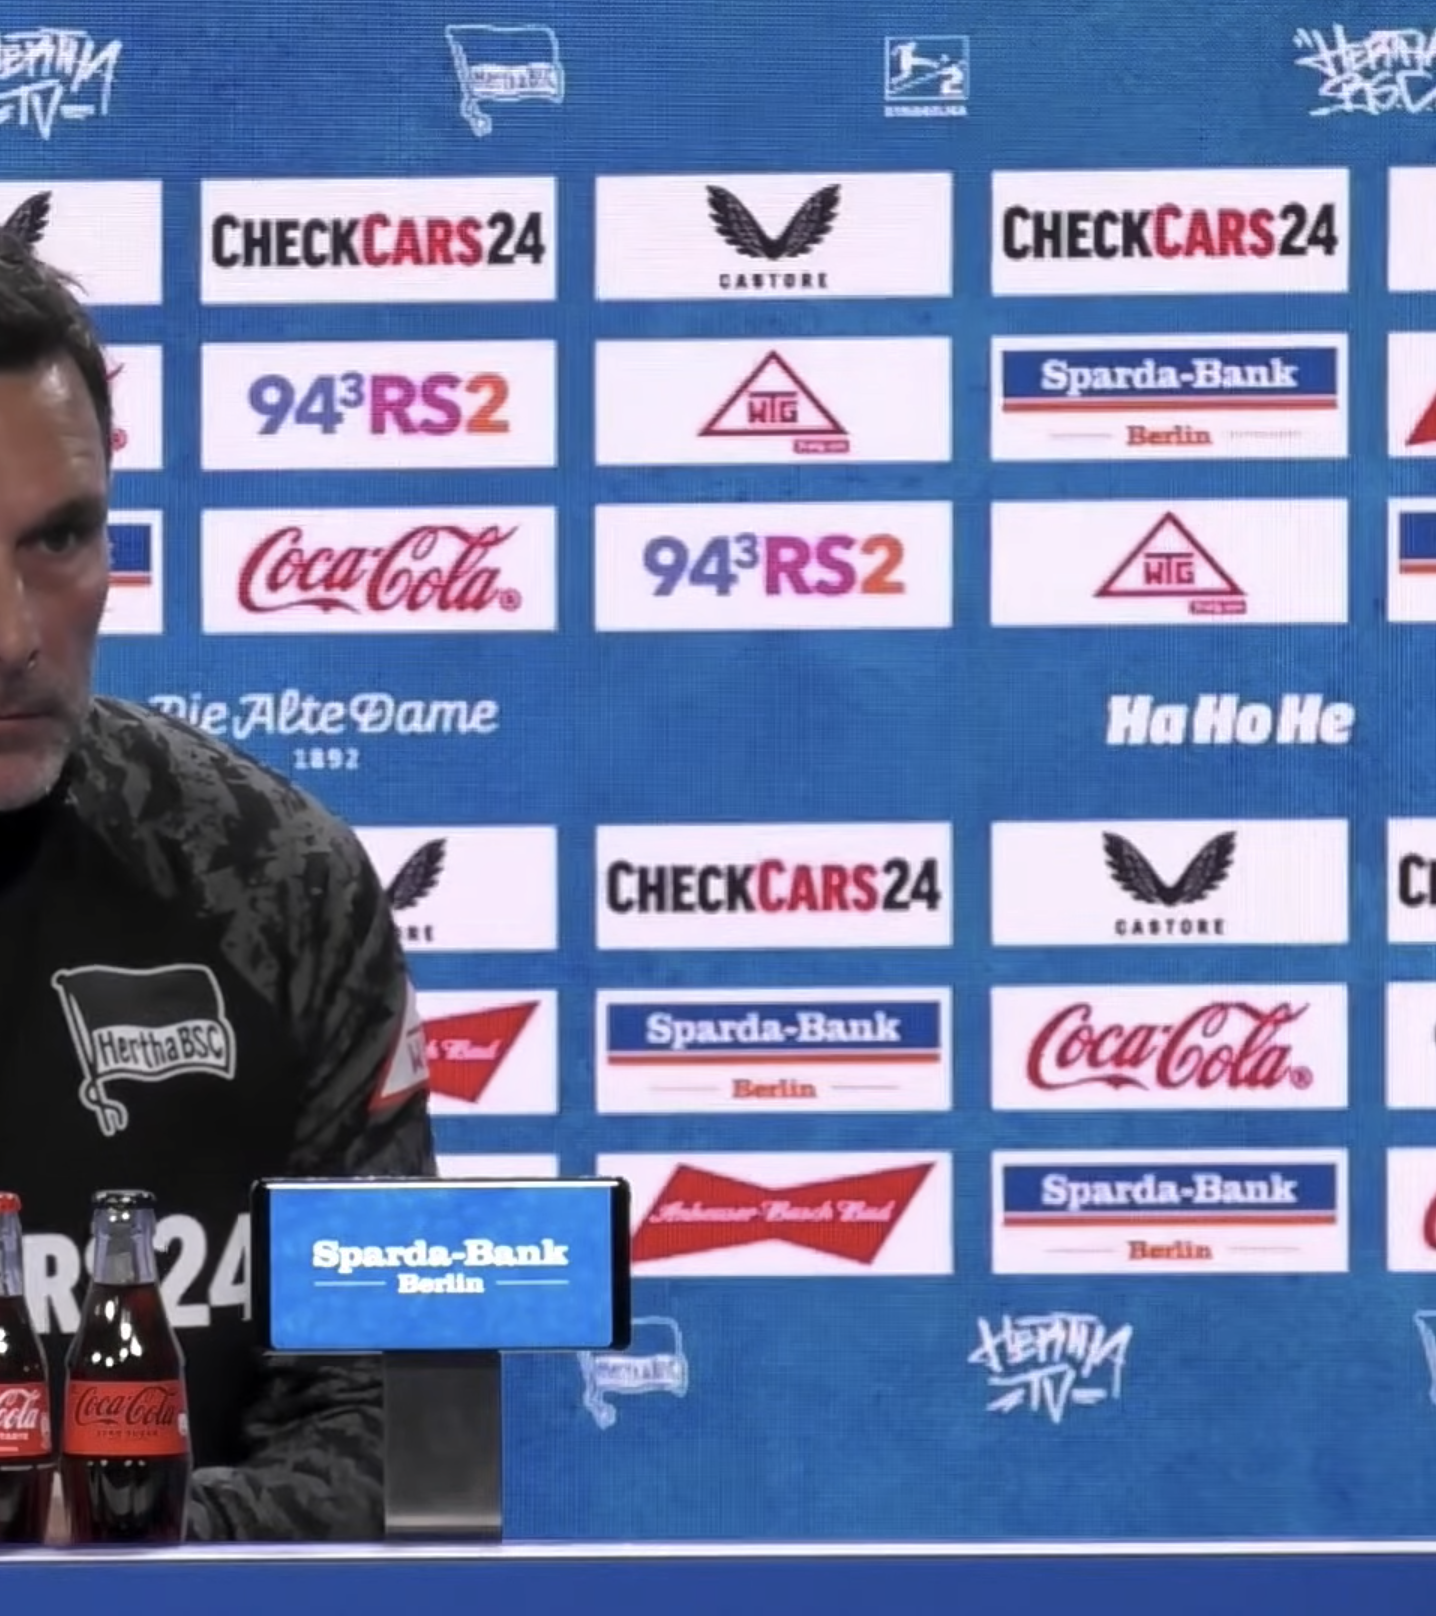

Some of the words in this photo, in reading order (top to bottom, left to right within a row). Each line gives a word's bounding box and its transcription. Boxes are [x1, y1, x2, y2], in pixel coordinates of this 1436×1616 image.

[719, 272, 827, 290] CASTORE
[1041, 358, 1297, 397] Sparda-Bank
[1127, 425, 1212, 446] Berlin
[237, 525, 520, 614] Coca-Cola
[232, 688, 347, 740] Alte
[348, 693, 498, 734] Dame
[1115, 918, 1223, 936] CASTORE
[647, 1012, 900, 1049] Sparda-Bank
[1026, 1001, 1312, 1091] Coca-Cola
[732, 1078, 817, 1099] Berlin
[1042, 1174, 1301, 1213] Sparda-Bank
[312, 1238, 568, 1277] Sparda-Bank
[1128, 1240, 1212, 1260] Berlin
[397, 1273, 485, 1294] Berlin
[74, 1386, 178, 1427] Coca-Cola
